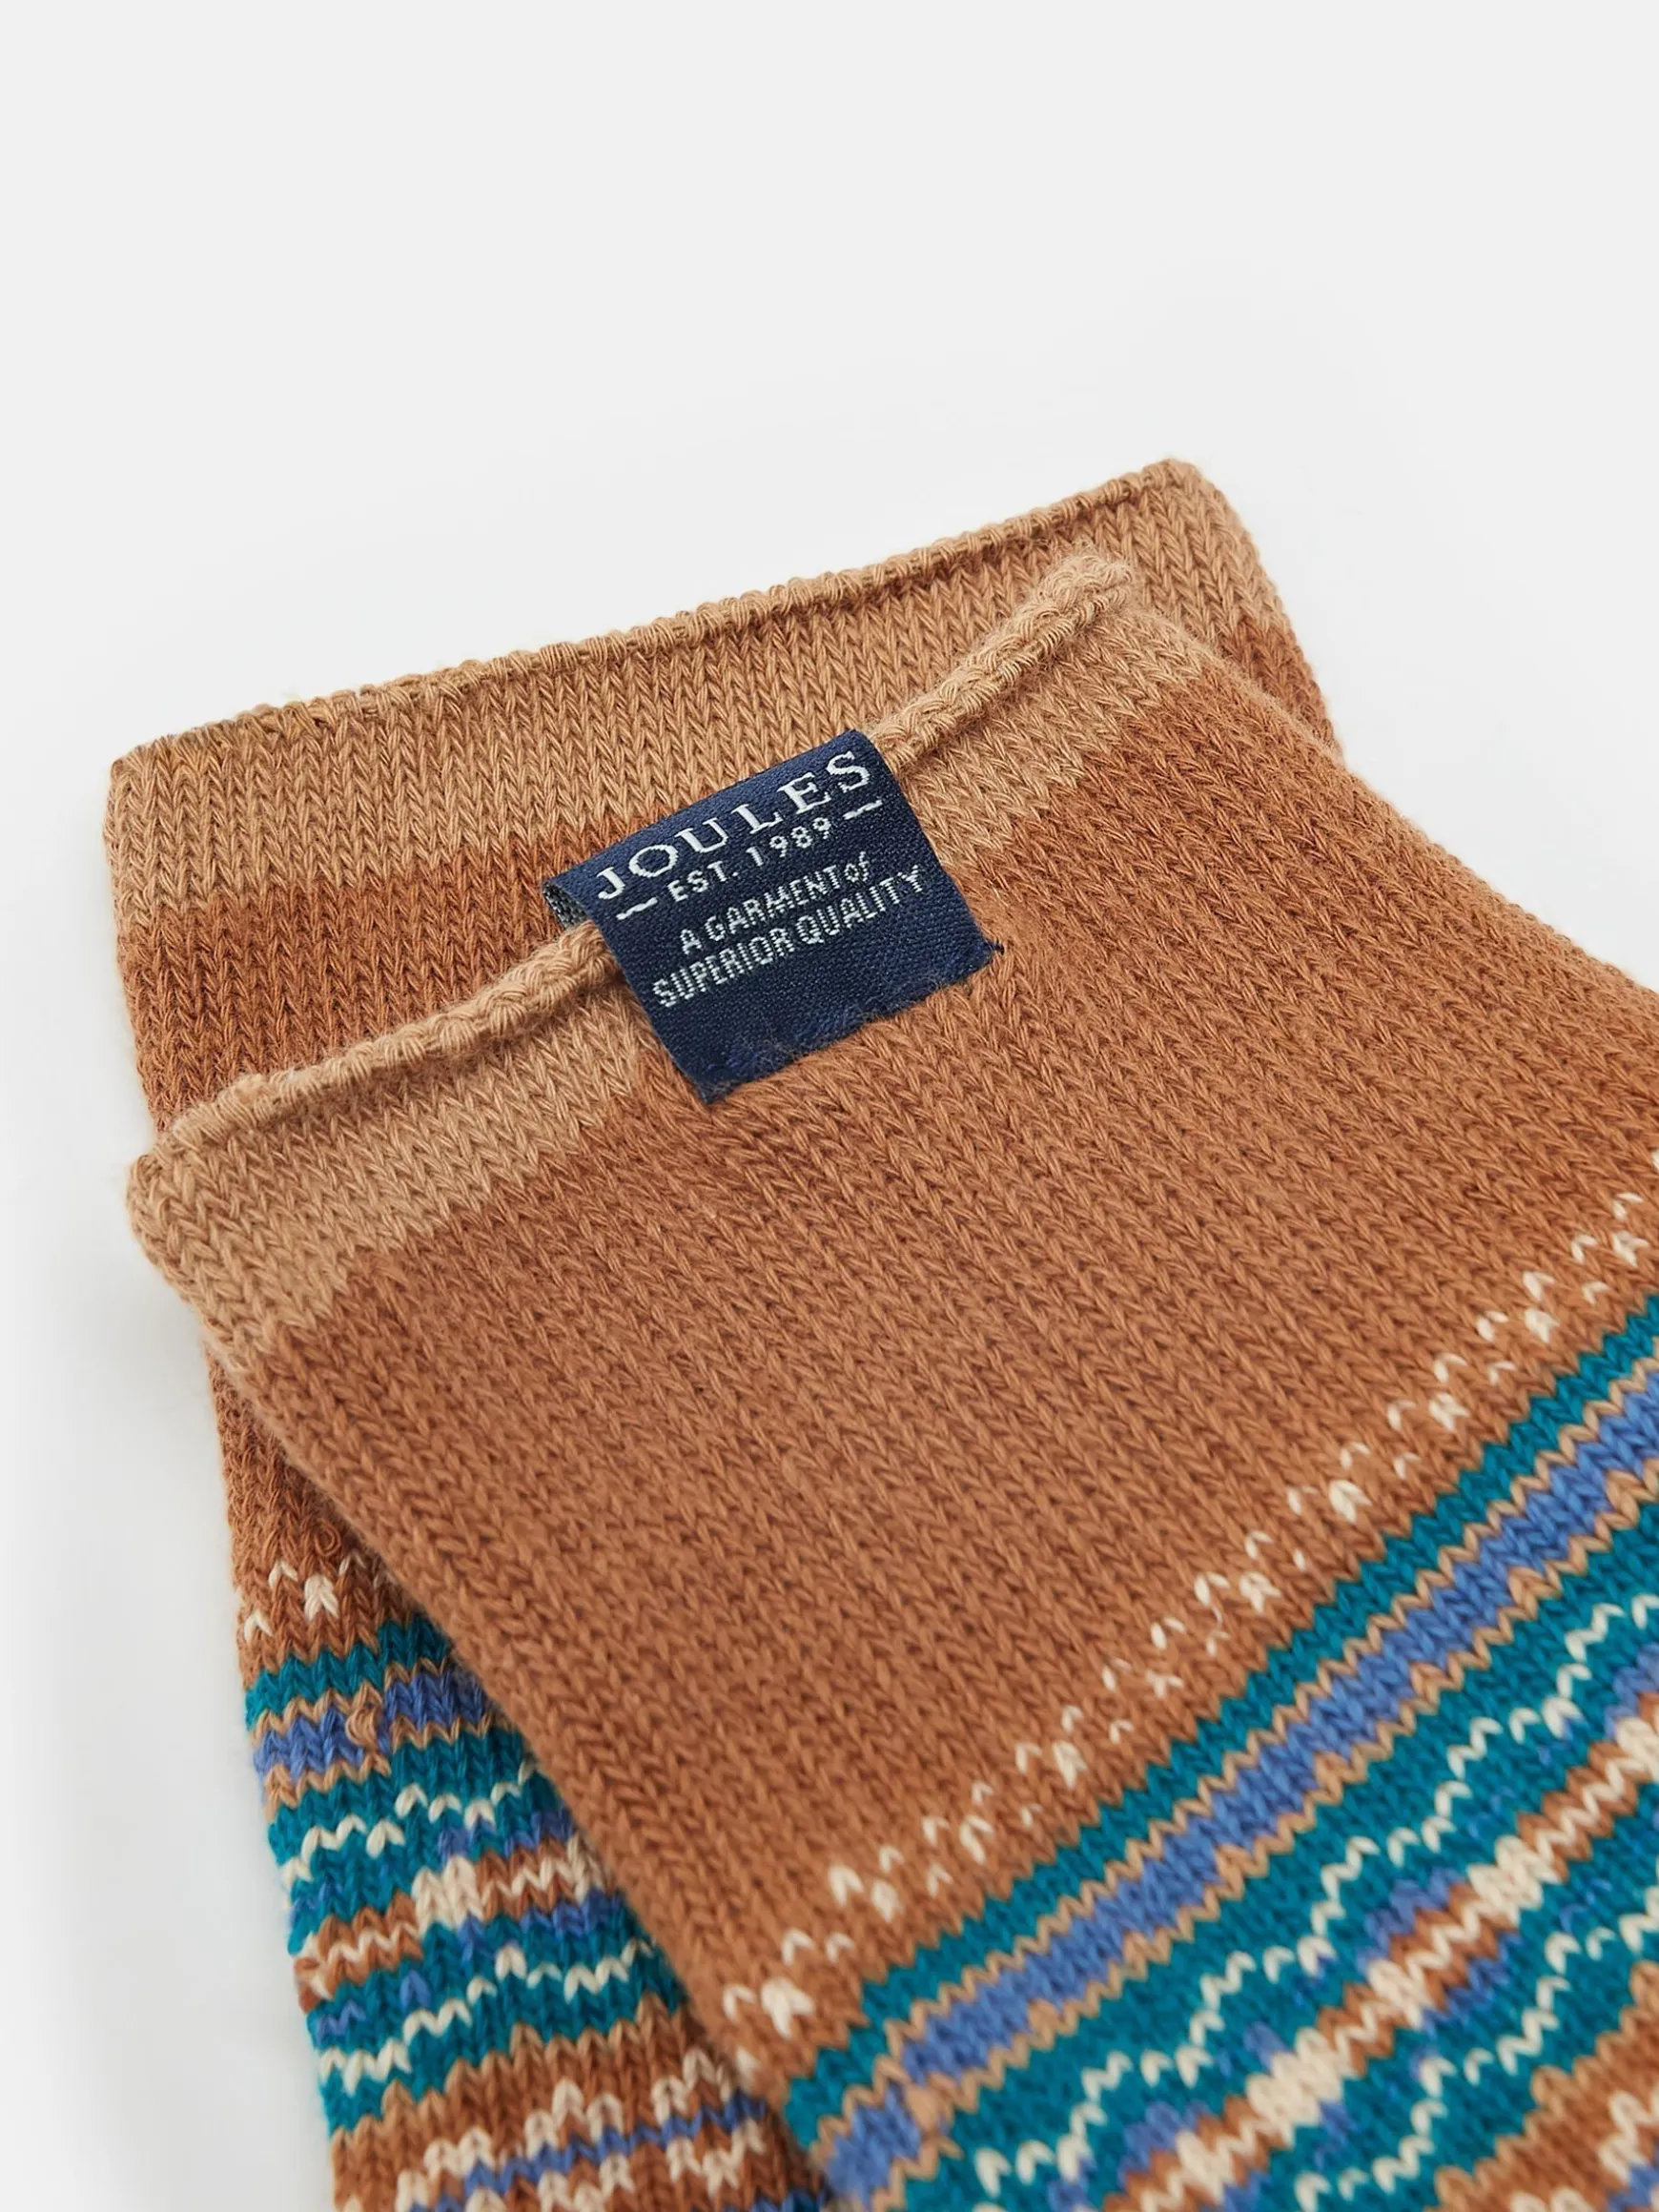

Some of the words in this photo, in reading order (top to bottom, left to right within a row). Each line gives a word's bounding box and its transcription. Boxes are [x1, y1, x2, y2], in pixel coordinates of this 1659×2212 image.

[596, 751, 871, 901] JOULES
[666, 860, 739, 903] EST.
[746, 817, 832, 868] 1989
[651, 928, 795, 1009] SUPERIOR
[794, 864, 924, 945] QUALITY
[679, 928, 703, 956] A
[704, 865, 840, 942] GARMENT
[843, 850, 871, 884] of
